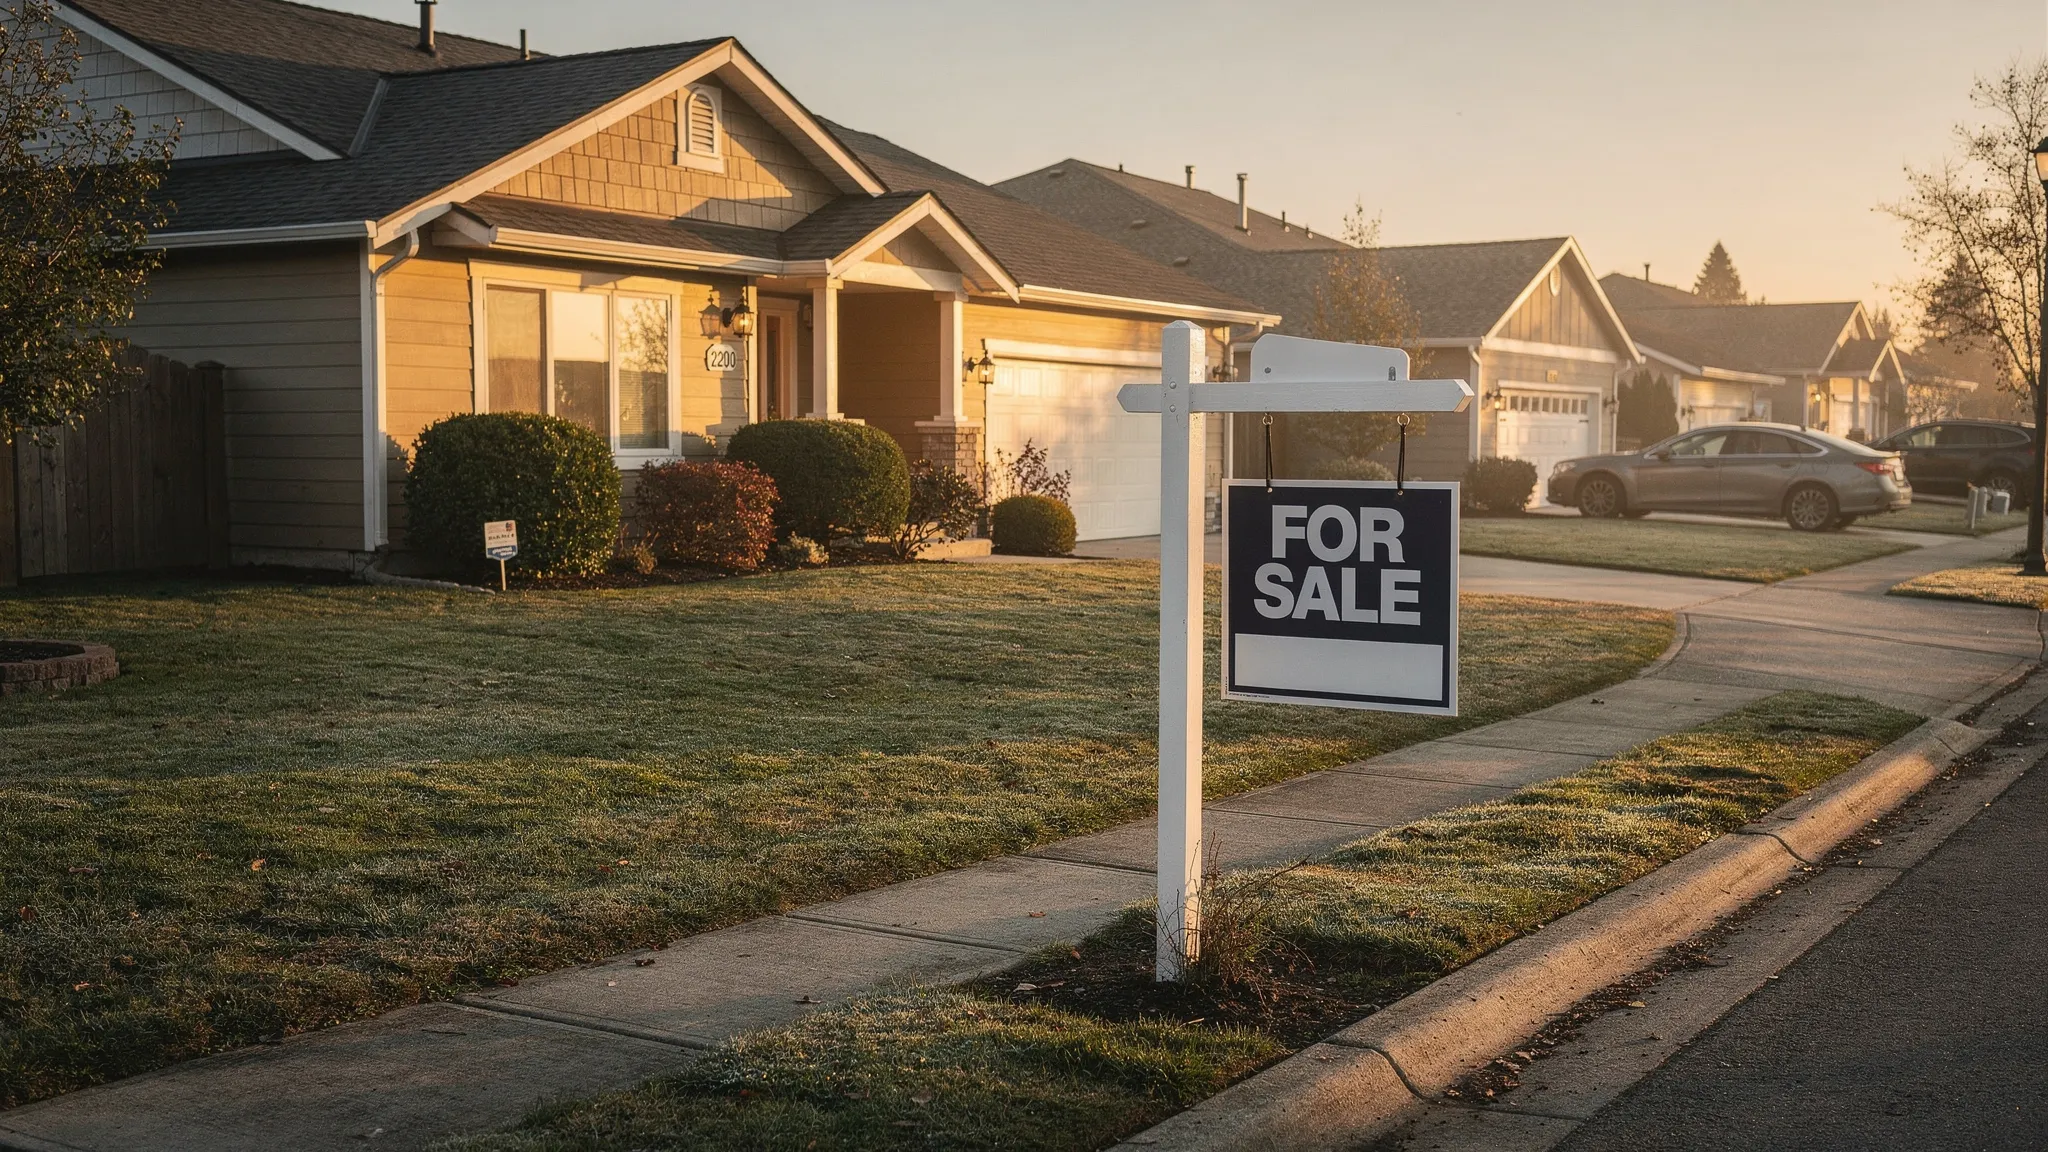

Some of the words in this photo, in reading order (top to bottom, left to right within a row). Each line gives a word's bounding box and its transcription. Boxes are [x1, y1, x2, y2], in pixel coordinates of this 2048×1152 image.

[711, 351, 736, 368] 2200
[1272, 504, 1406, 563] FOR
[1253, 562, 1421, 626] SALE
